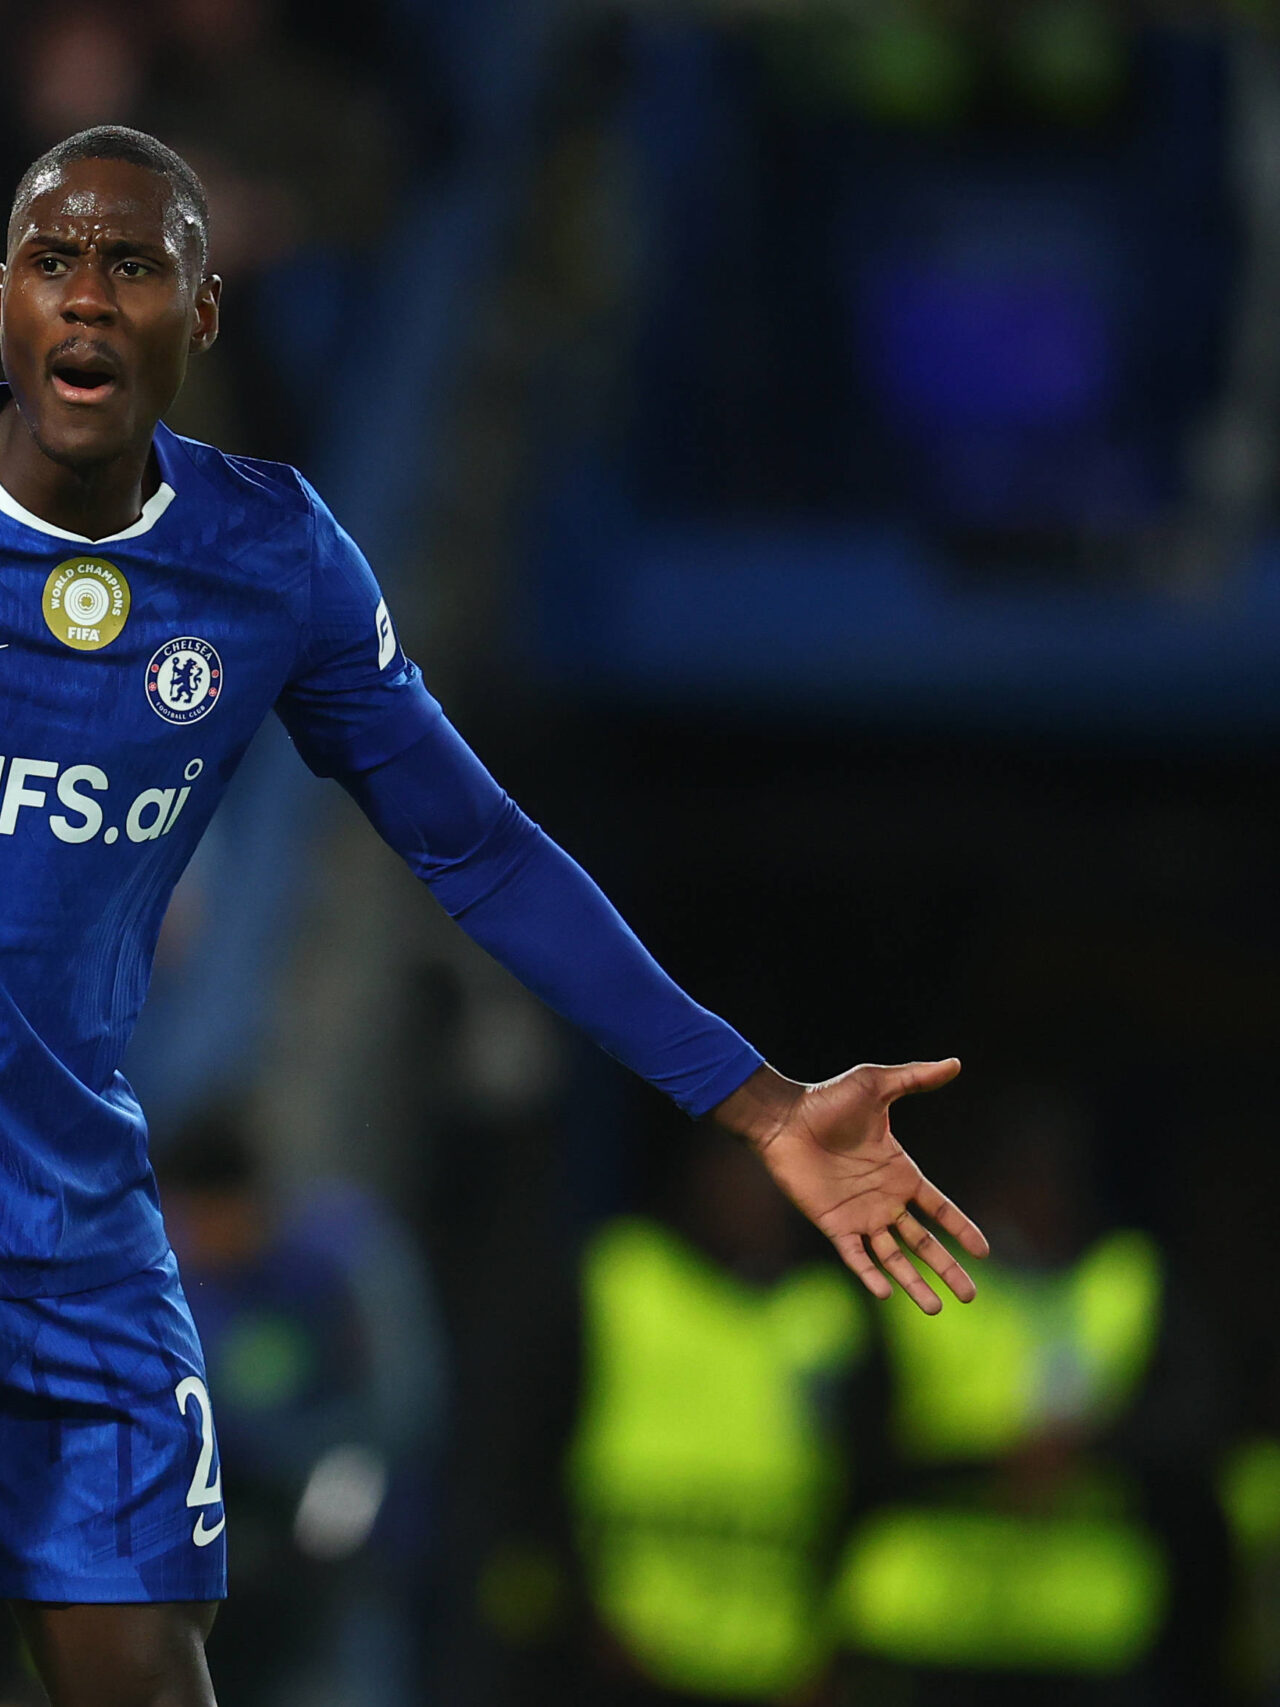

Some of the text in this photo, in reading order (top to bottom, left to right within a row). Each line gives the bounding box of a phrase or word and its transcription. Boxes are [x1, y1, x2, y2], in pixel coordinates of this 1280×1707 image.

[51, 564, 123, 616] WORLD CHAMPIONS
[67, 627, 100, 642] FIFA
[163, 640, 213, 661] CHELSEA
[155, 701, 206, 720] FOOTBALL CLUB
